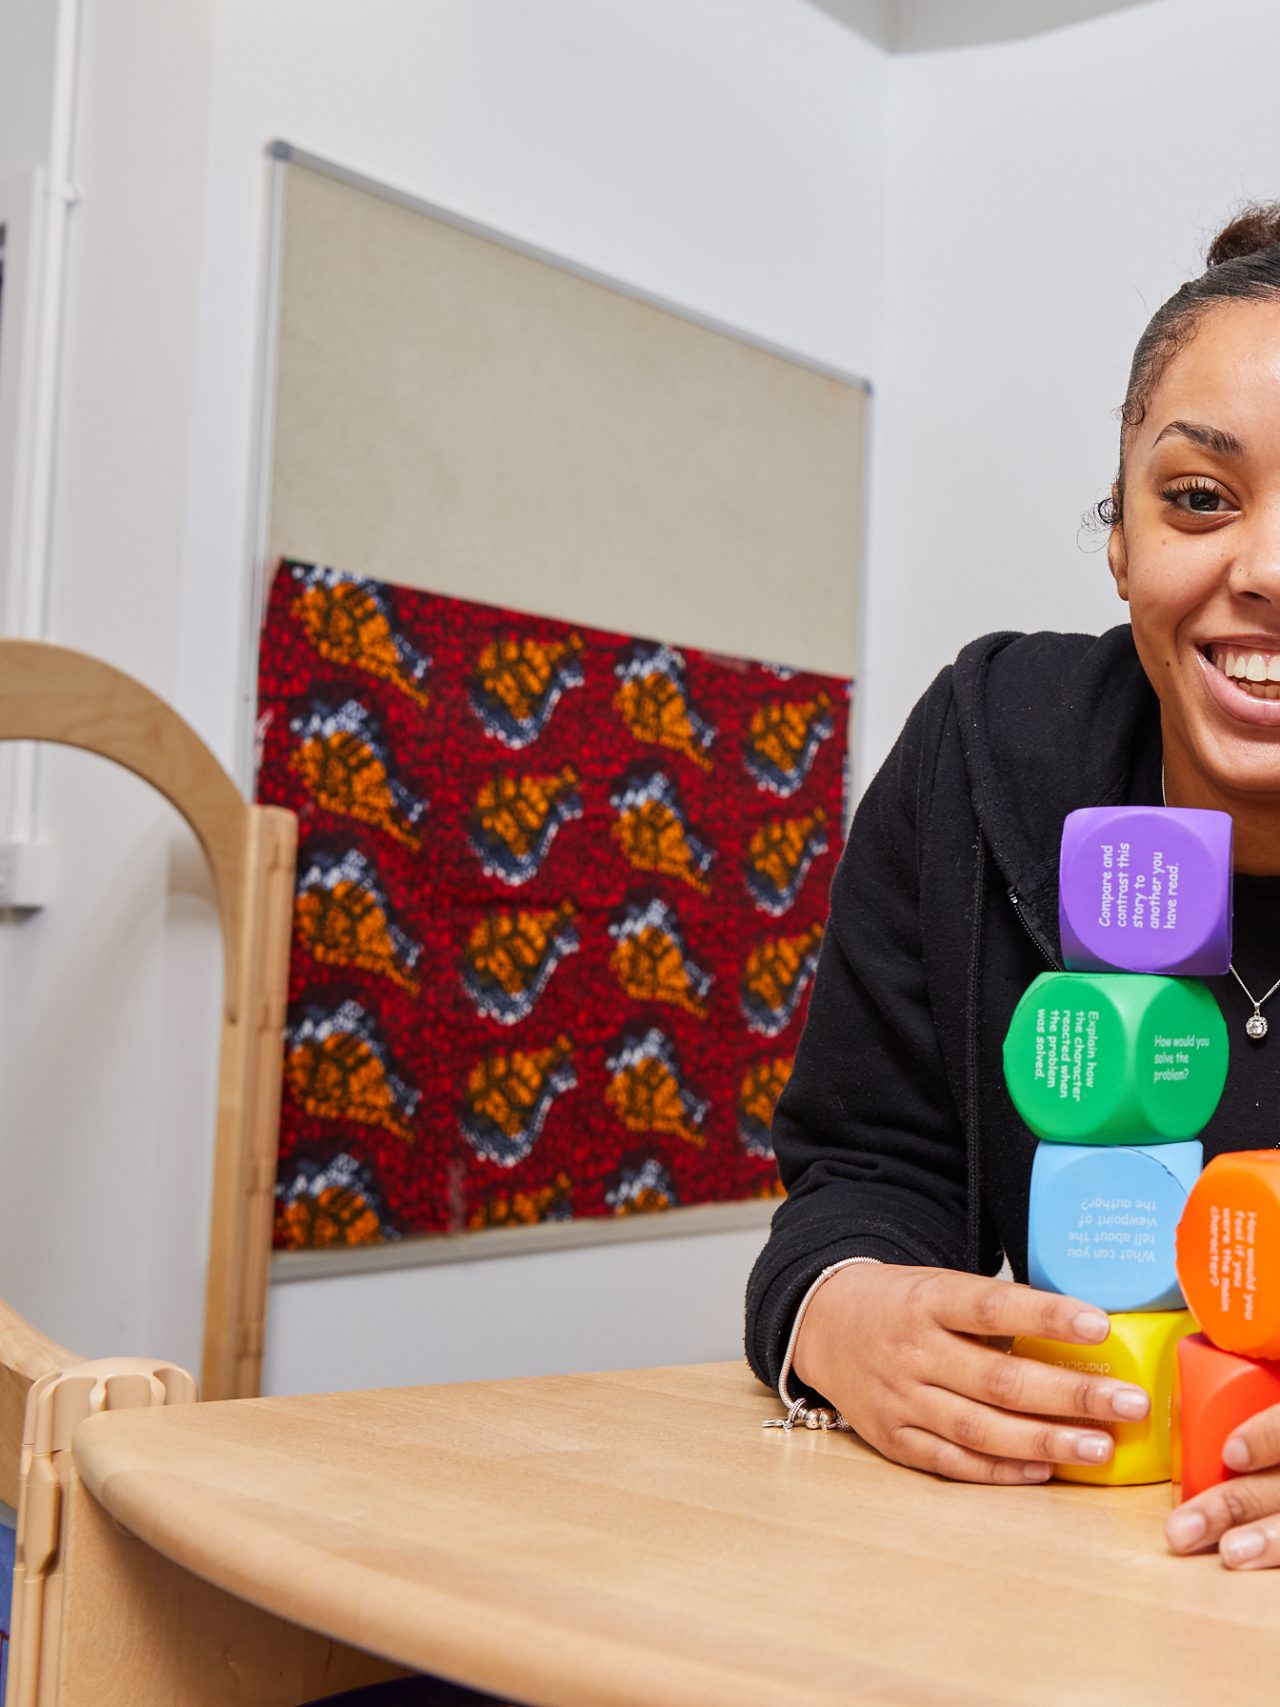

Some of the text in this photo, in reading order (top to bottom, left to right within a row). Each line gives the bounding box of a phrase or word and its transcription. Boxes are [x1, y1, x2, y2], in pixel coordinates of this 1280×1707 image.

[1098, 845, 1114, 927] Compare and
[1116, 843, 1130, 927] contrast this
[1132, 874, 1147, 928] story to
[1149, 852, 1165, 929] another you
[1163, 863, 1179, 929] have read.
[1034, 1009, 1046, 1080] was solved.
[1047, 1009, 1060, 1088] the problem
[1059, 1009, 1071, 1098] reacted when
[1072, 1010, 1085, 1102] the character
[1085, 1010, 1099, 1088] Explain how
[1154, 1035, 1209, 1049] How would you
[1154, 1052, 1189, 1064] solve the
[1154, 1069, 1189, 1084] problem?
[1067, 1231, 1156, 1246] tell about the
[1077, 1214, 1157, 1228] viewpoint of
[1080, 1198, 1158, 1212] the author?
[1067, 1246, 1156, 1263] What can you
[1209, 1205, 1220, 1287] character?
[1220, 1207, 1233, 1312] were the main
[1232, 1210, 1246, 1288] feel if you
[1243, 1211, 1258, 1320] How would you
